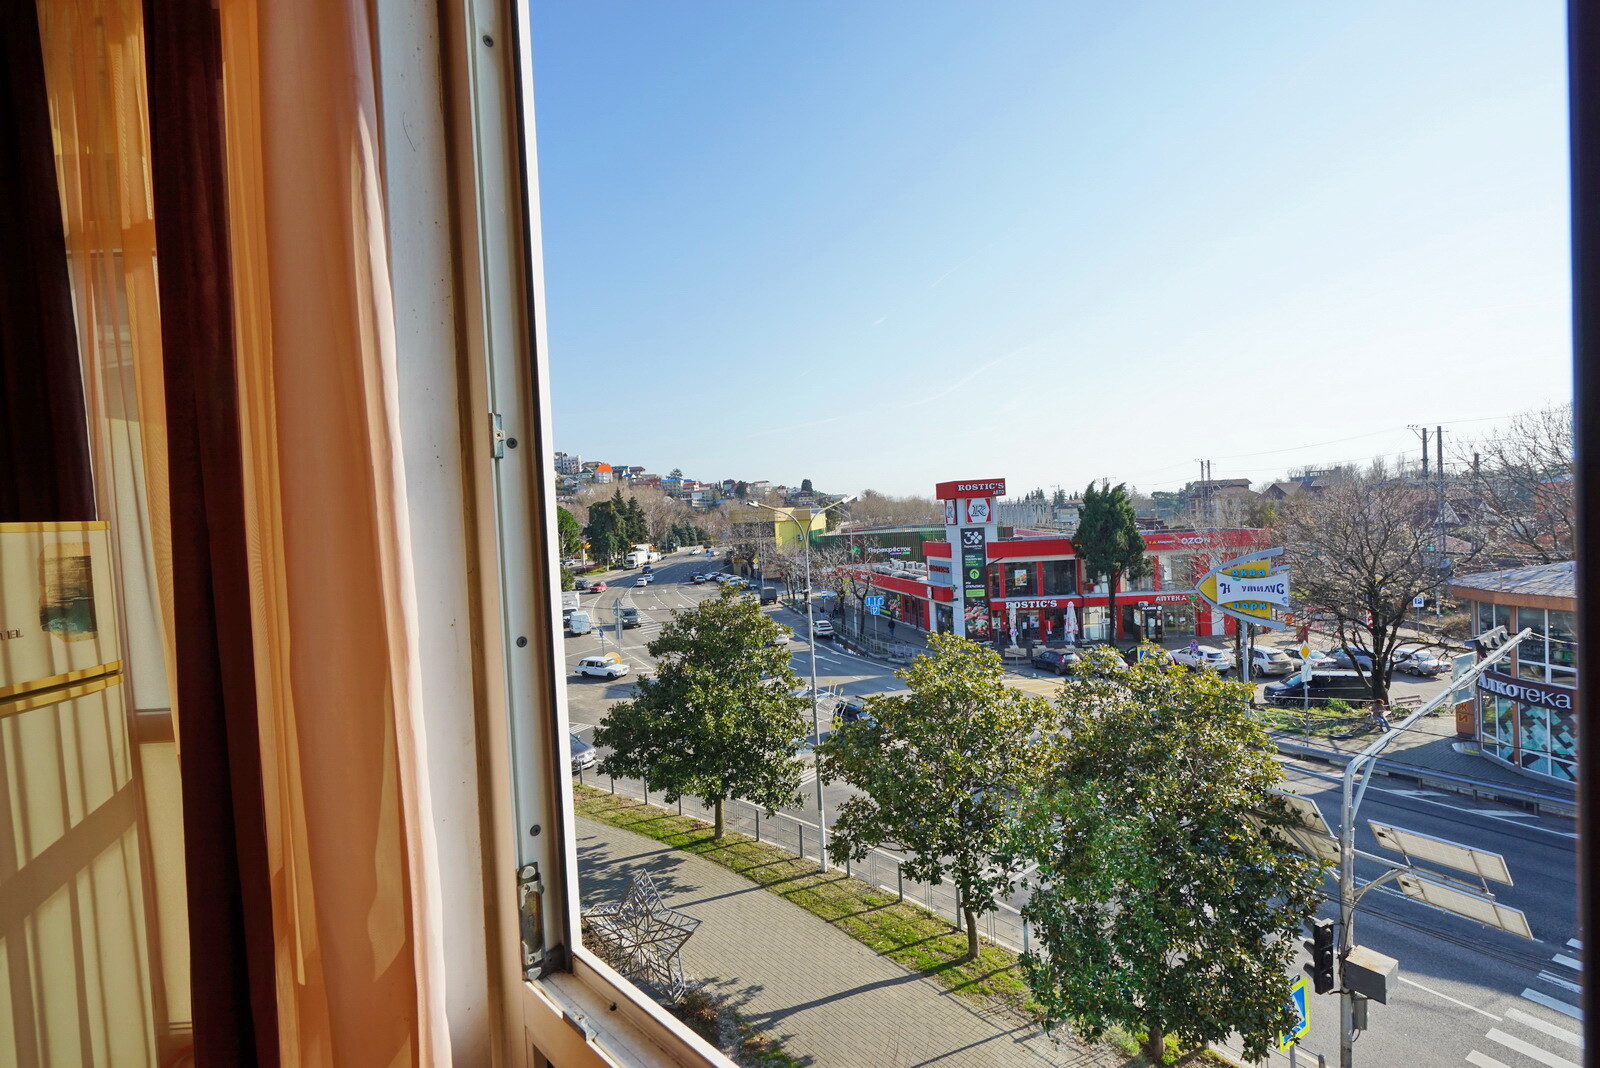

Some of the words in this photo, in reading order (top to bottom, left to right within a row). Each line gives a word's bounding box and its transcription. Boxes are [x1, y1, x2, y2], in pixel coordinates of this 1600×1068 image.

[958, 482, 1004, 492] ROSTIC'S
[1181, 537, 1211, 545] OZON
[1233, 602, 1267, 611] парк
[1477, 672, 1572, 710] Алкотека
